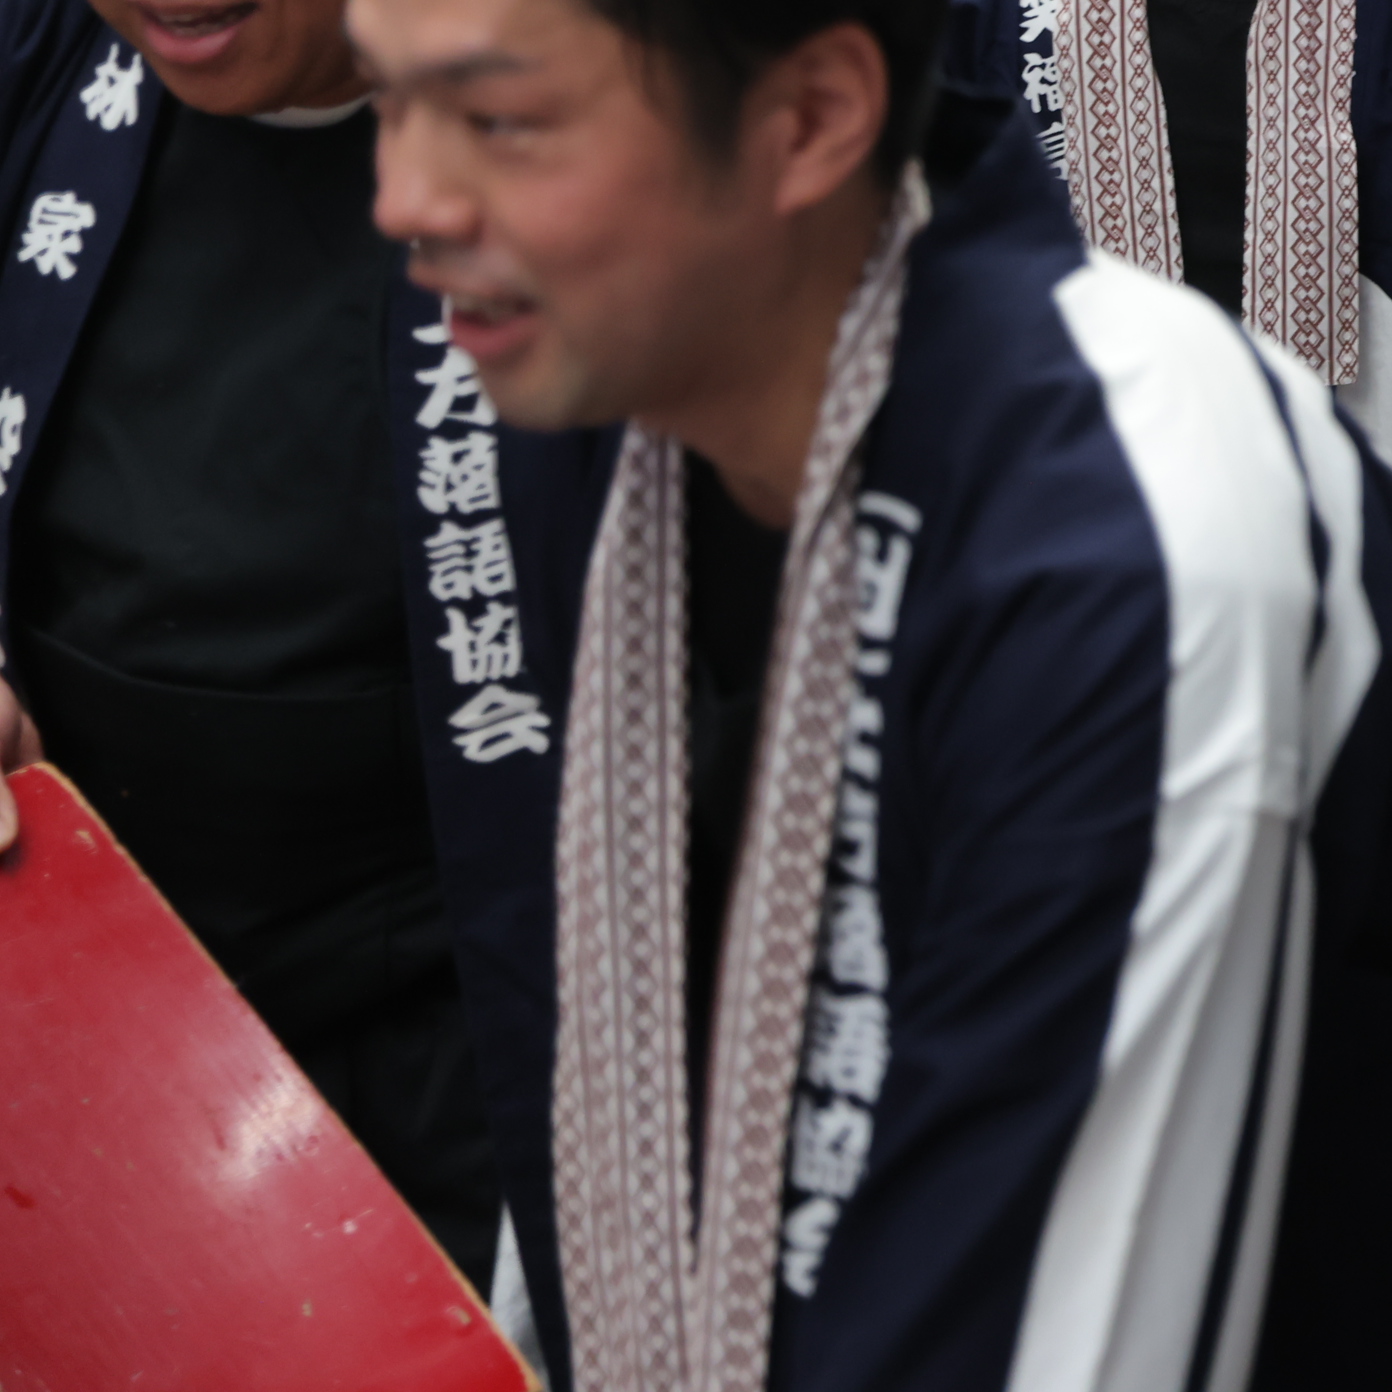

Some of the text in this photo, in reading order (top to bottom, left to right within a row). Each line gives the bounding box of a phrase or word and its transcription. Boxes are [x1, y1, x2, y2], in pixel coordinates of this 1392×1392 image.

[412, 294, 551, 764] 方落語協会
